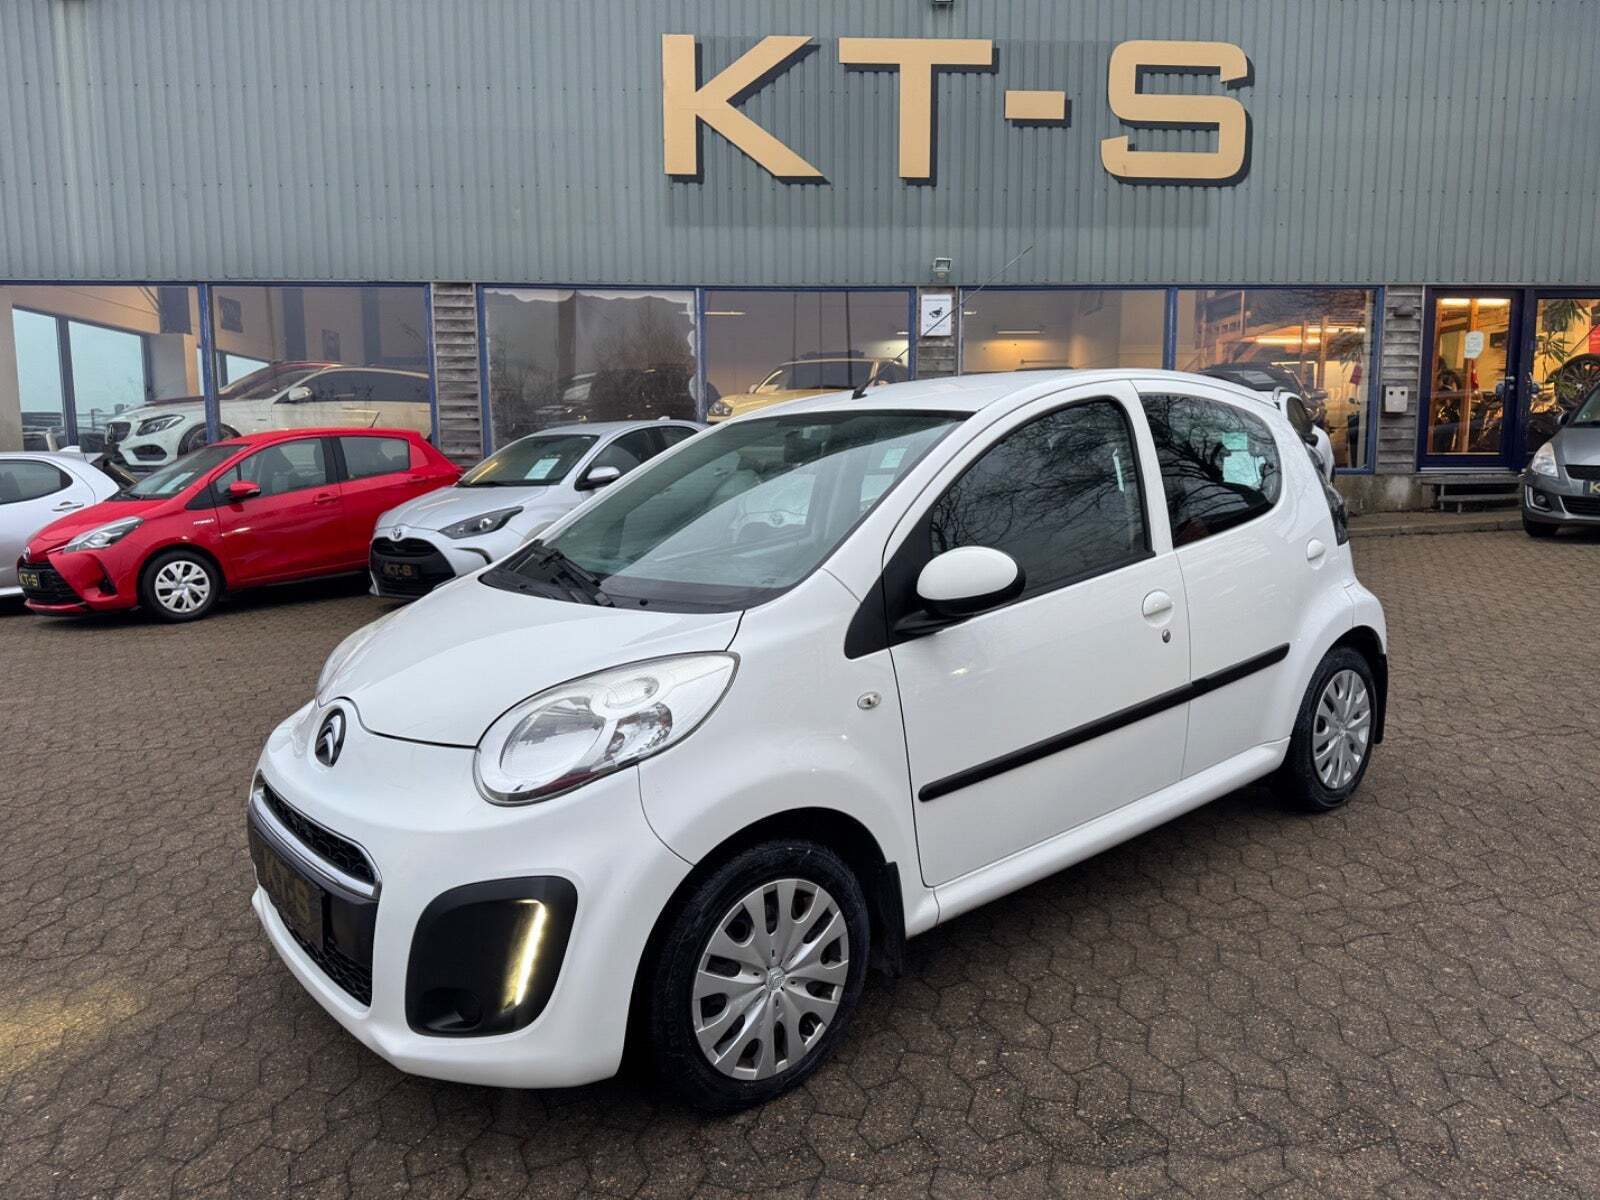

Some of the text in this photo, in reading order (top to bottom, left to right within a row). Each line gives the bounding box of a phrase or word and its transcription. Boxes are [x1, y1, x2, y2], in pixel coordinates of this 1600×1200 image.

[663, 34, 1248, 180] KT-S
[384, 562, 413, 577] KT-S
[19, 572, 38, 587] KT-S
